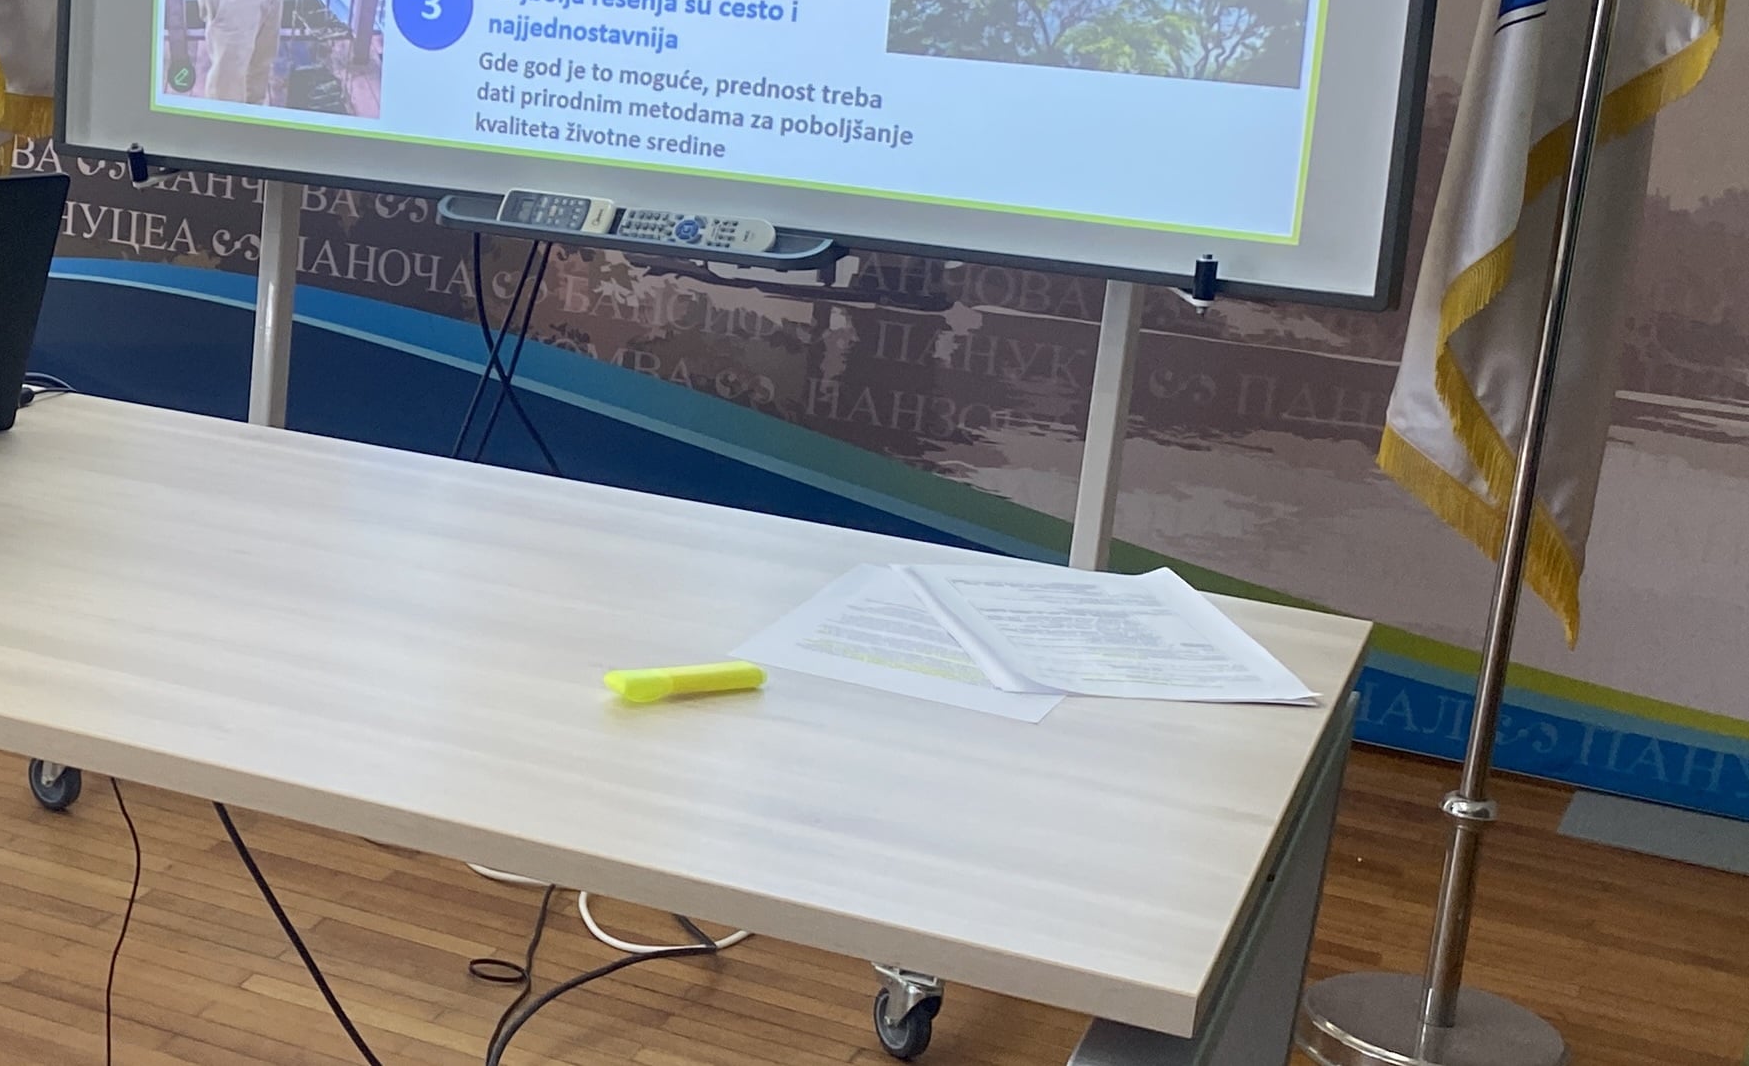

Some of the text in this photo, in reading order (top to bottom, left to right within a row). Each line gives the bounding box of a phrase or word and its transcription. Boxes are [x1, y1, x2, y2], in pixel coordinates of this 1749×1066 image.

[488, 16, 679, 53] najjednostavnija
[790, 0, 799, 23] i
[478, 52, 884, 110] Gde god je to moguće, prednost treba
[475, 112, 726, 159] kvaliteta životne sredine
[476, 82, 914, 147] dati prirodnim metodama za poboljšanje
[61, 200, 201, 255] НУЦЕА
